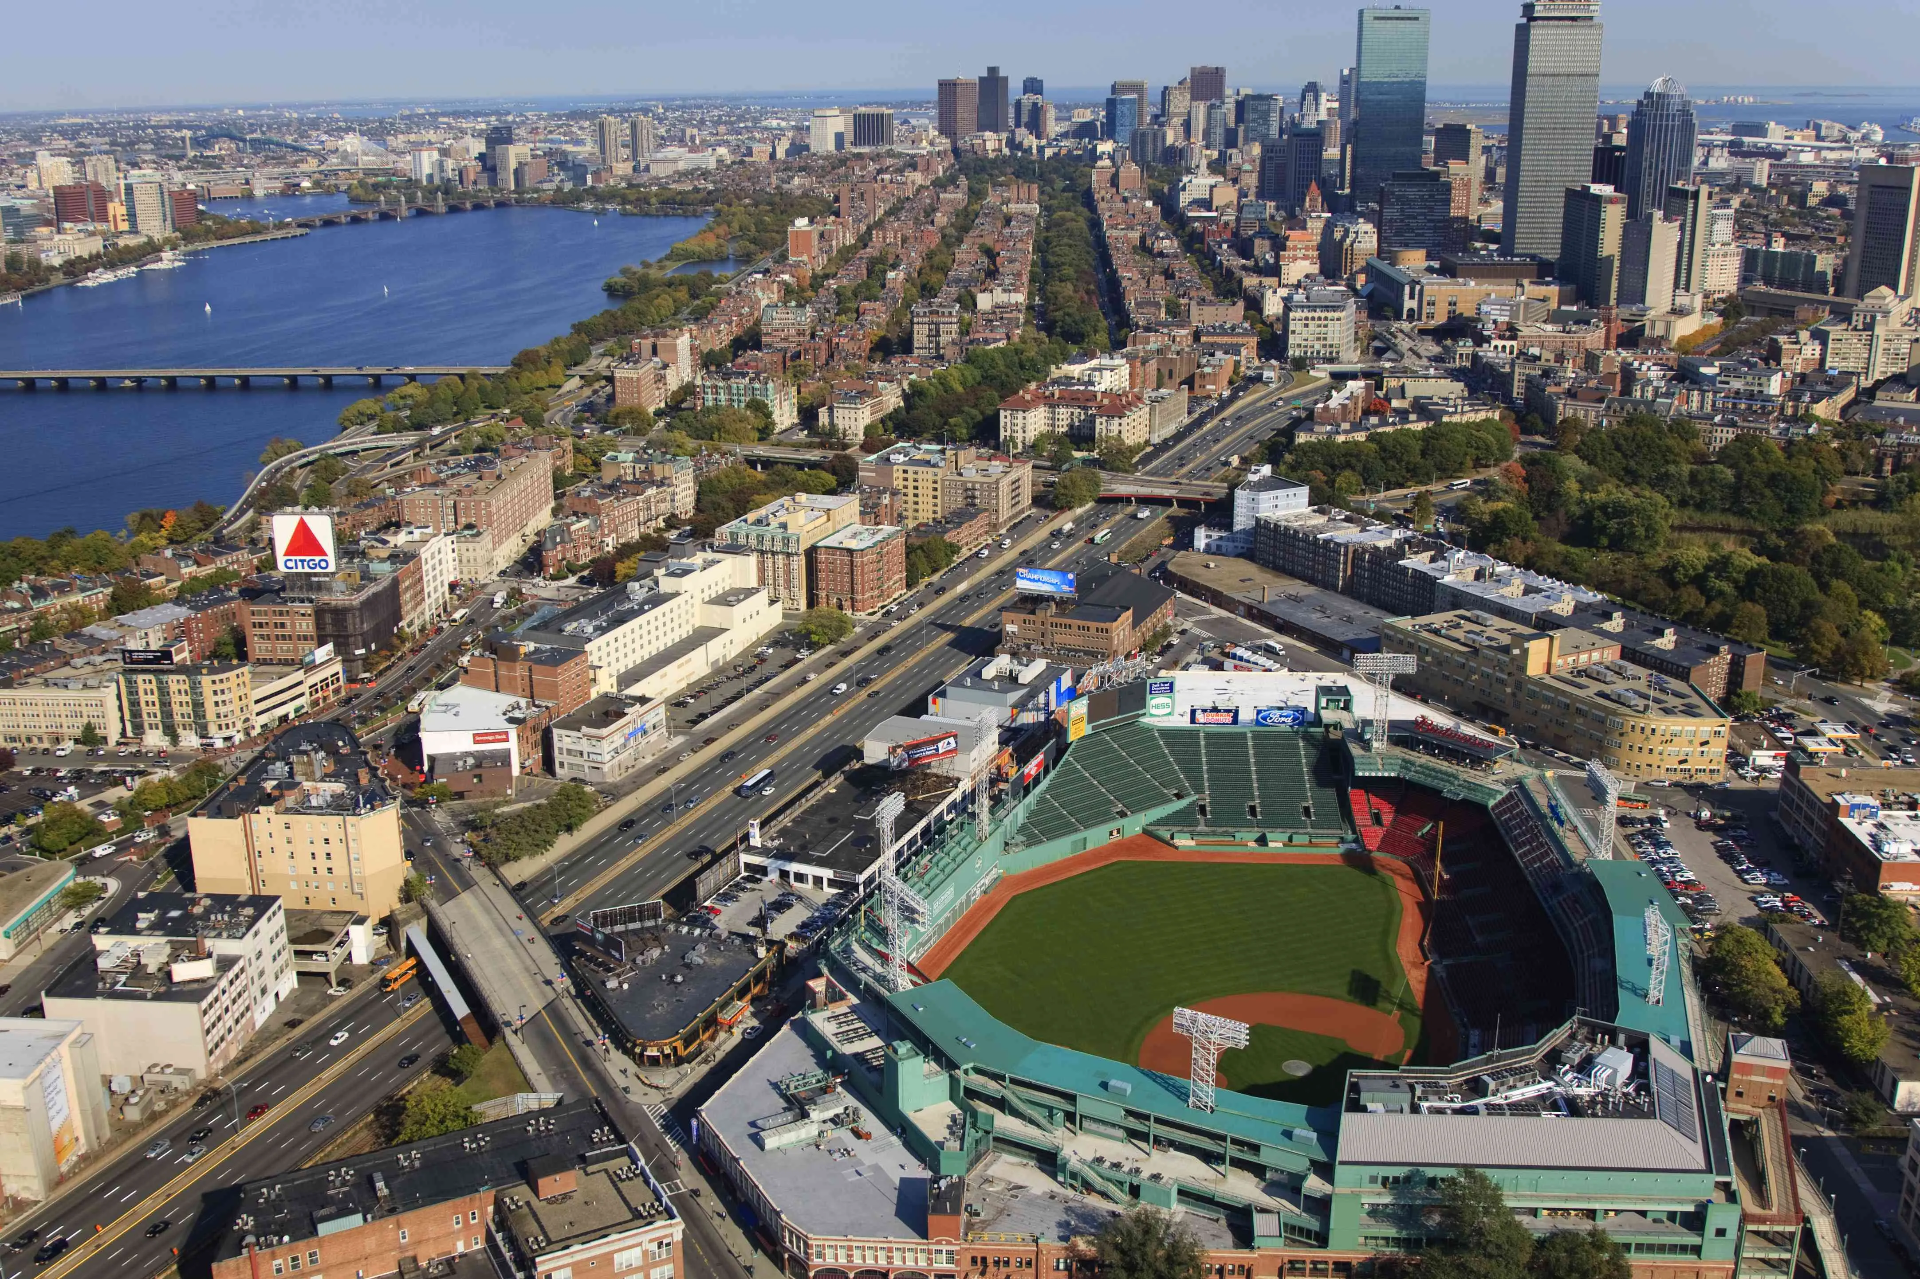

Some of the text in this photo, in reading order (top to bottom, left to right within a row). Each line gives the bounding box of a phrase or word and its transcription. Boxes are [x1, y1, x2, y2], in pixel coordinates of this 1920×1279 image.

[284, 558, 329, 570] CITGO
[1151, 702, 1171, 710] HESS
[1266, 712, 1294, 723] Ford
